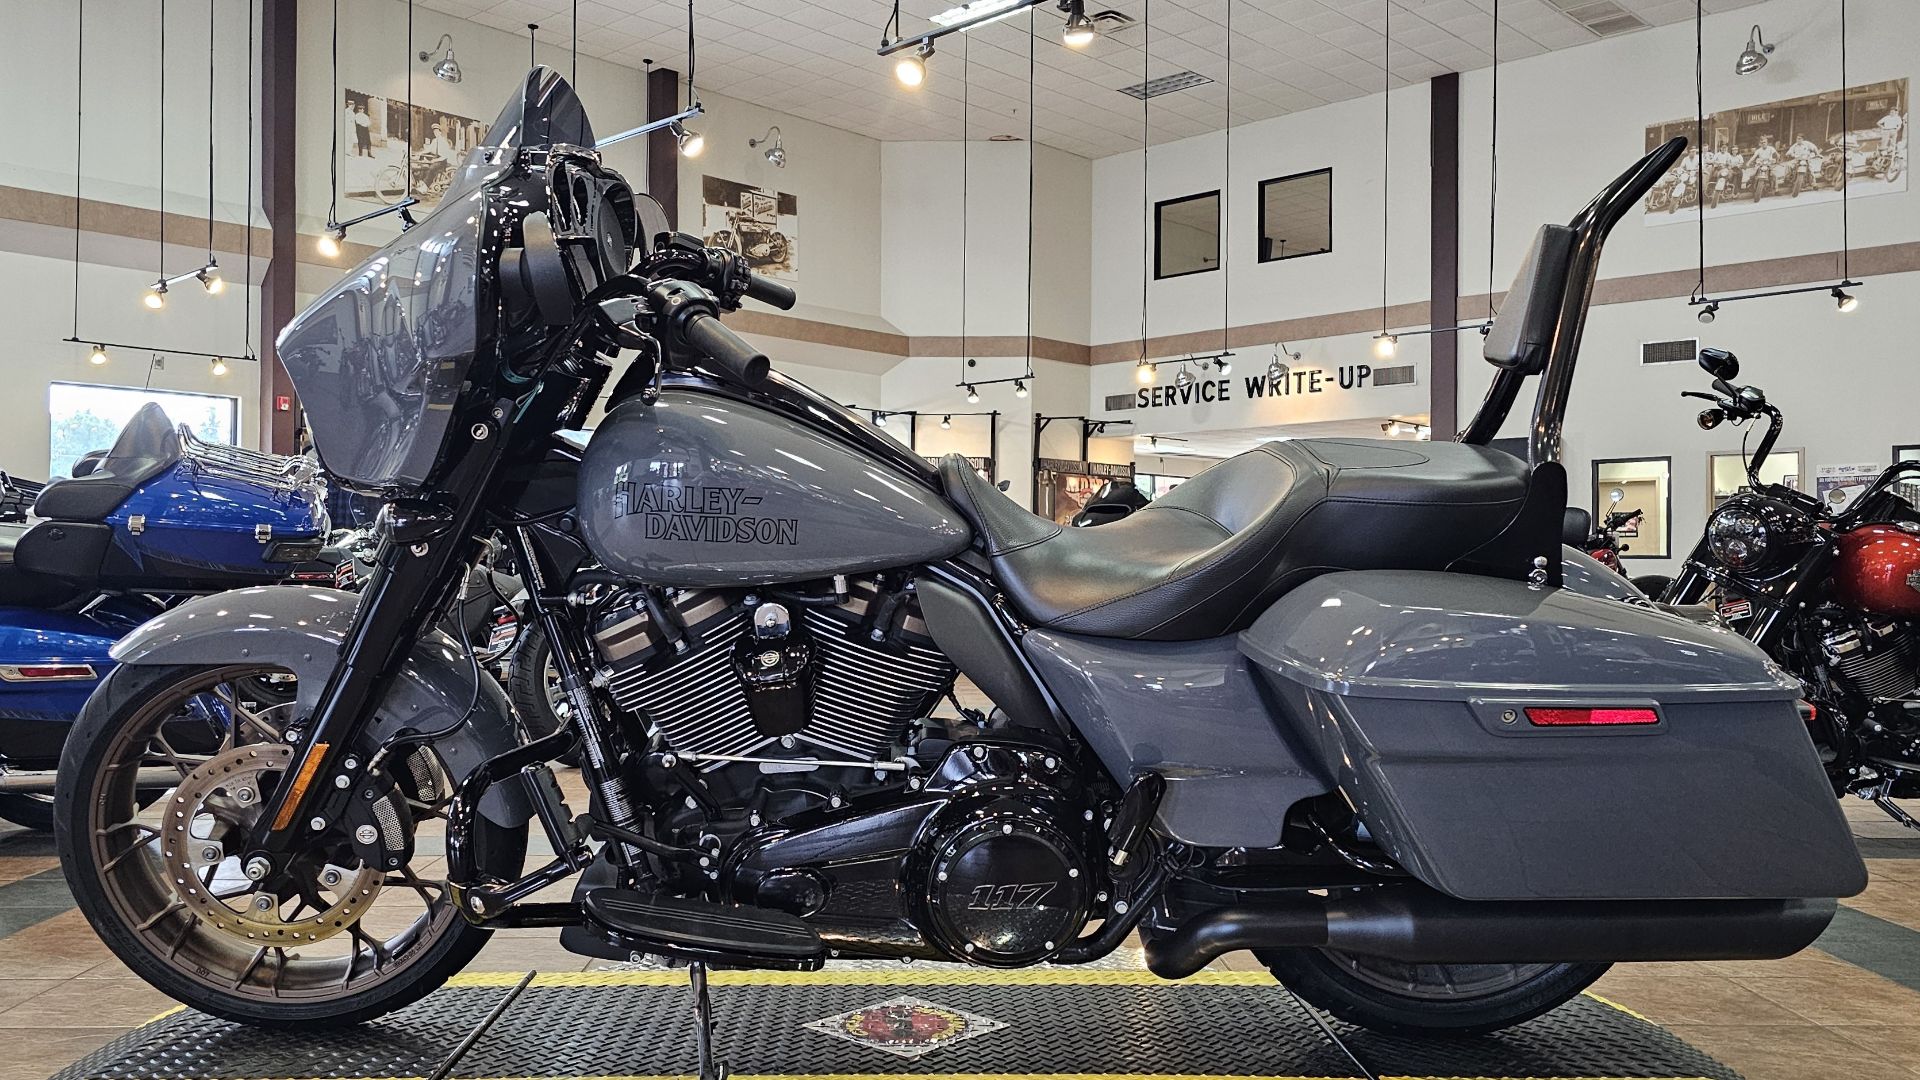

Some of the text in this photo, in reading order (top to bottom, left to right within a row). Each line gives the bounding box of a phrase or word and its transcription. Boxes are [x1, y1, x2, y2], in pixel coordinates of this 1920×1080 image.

[1137, 364, 1371, 408] SERVICE WRITE-UP
[614, 481, 763, 519] HARLEY-
[645, 513, 798, 545] DAVIDSON
[968, 882, 1057, 910] 117
